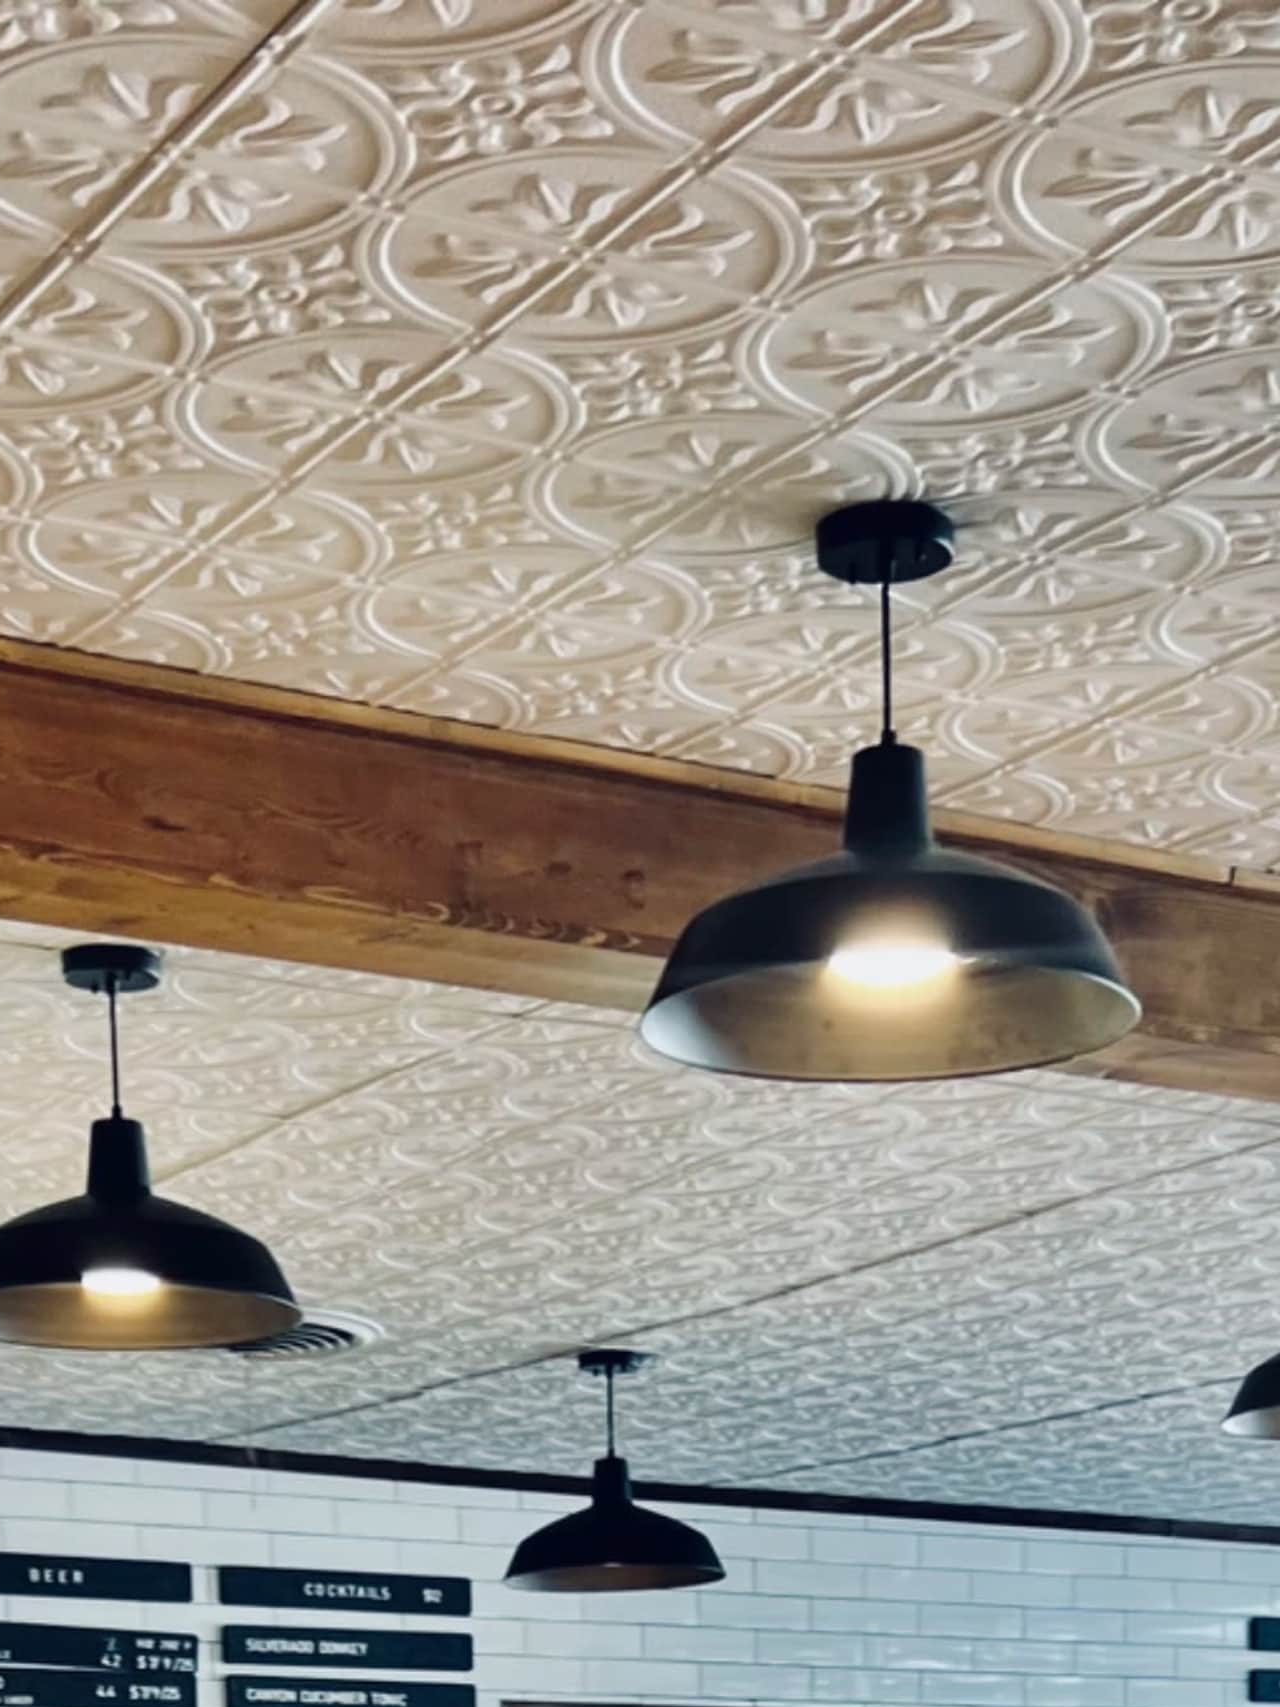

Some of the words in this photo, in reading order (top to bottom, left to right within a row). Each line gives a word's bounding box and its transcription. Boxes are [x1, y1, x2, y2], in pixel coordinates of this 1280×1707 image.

[28, 1567, 84, 1584] BEER
[303, 1582, 392, 1602] COCKTAILS
[370, 1691, 408, 1707] TONIC
